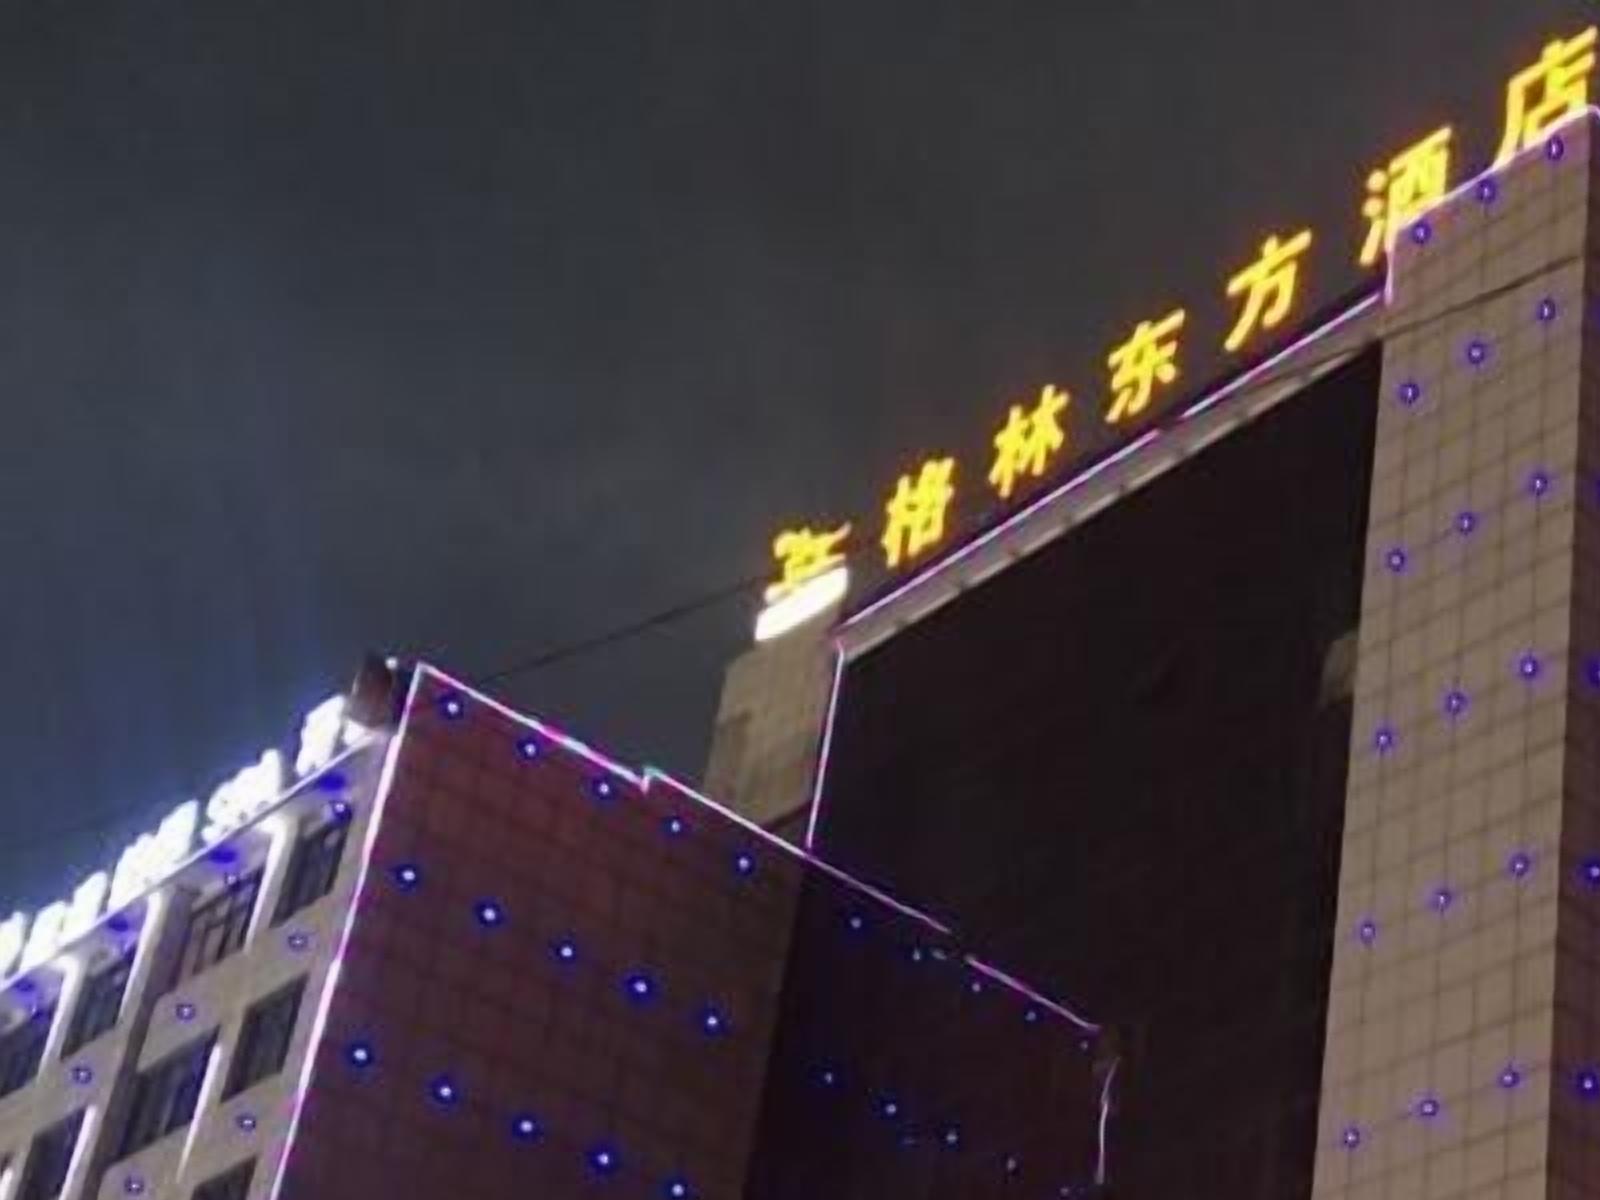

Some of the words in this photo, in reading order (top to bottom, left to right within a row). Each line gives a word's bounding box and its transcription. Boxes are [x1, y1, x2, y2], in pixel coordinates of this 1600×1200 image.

[881, 26, 1597, 566] 格林东方酒店
